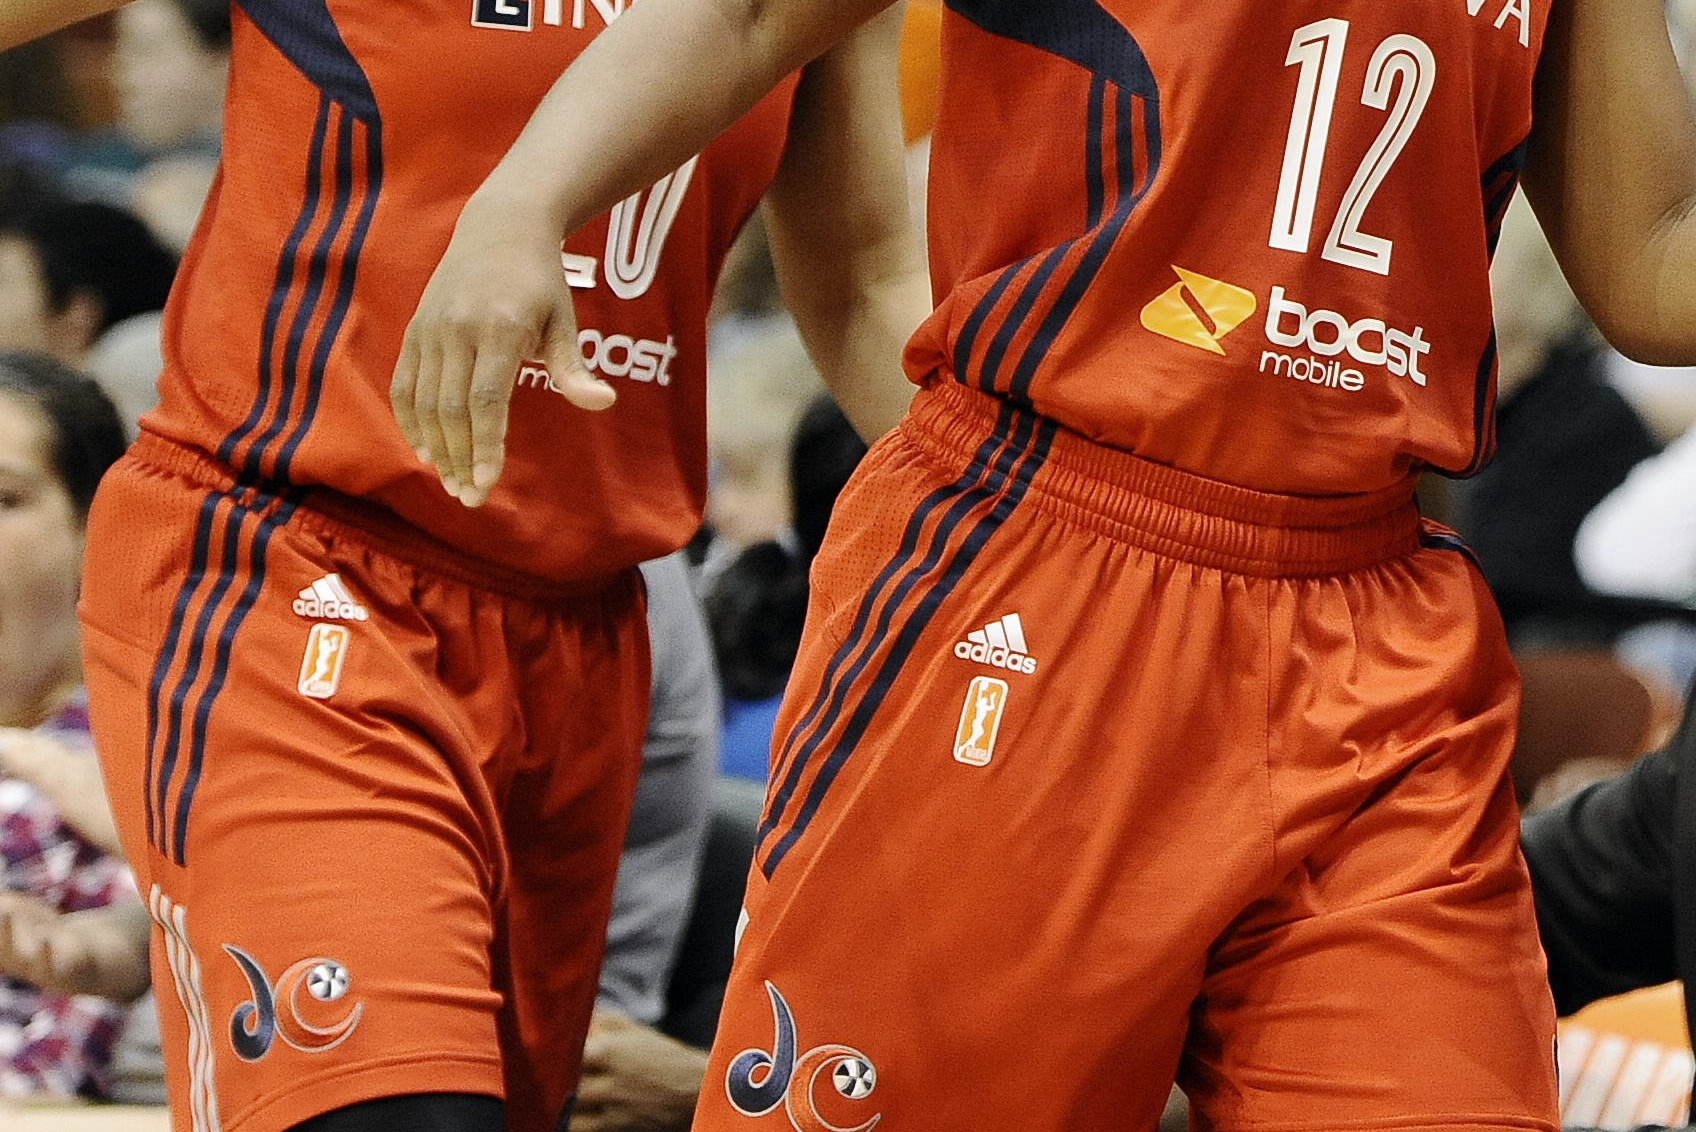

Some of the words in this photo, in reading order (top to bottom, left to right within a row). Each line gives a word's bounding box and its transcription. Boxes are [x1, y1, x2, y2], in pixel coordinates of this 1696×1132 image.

[1267, 17, 1437, 276] 12
[576, 328, 677, 387] oost
[1265, 285, 1431, 387] boost
[1258, 350, 1365, 392] mobile
[293, 598, 369, 621] adidas
[954, 640, 1037, 675] adidas
